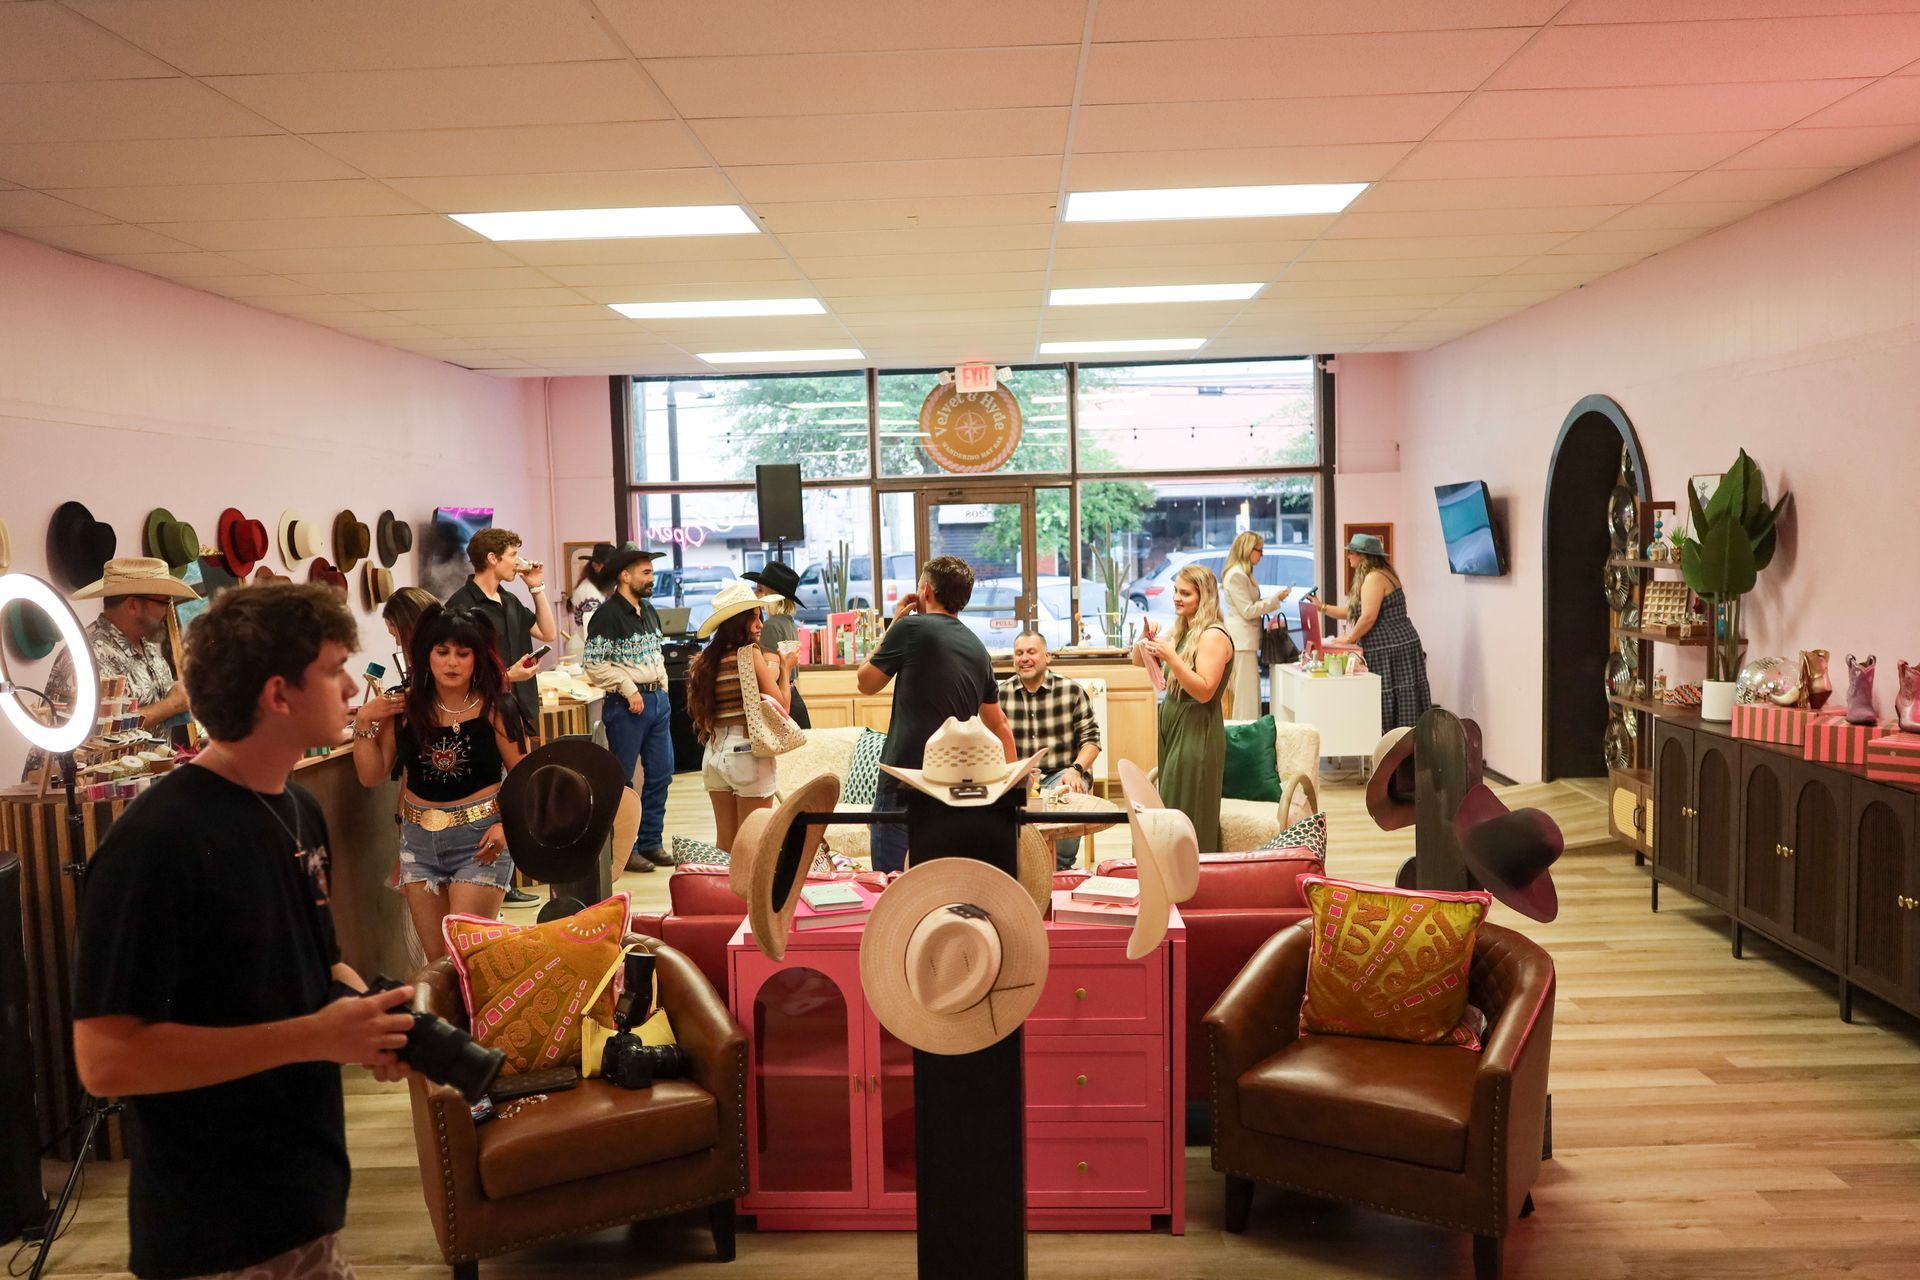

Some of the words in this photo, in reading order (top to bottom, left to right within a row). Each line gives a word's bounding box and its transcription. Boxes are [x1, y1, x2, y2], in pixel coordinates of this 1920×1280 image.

[962, 367, 991, 387] EXIT
[934, 393, 965, 437] Velvet
[980, 393, 1006, 431] Hyde
